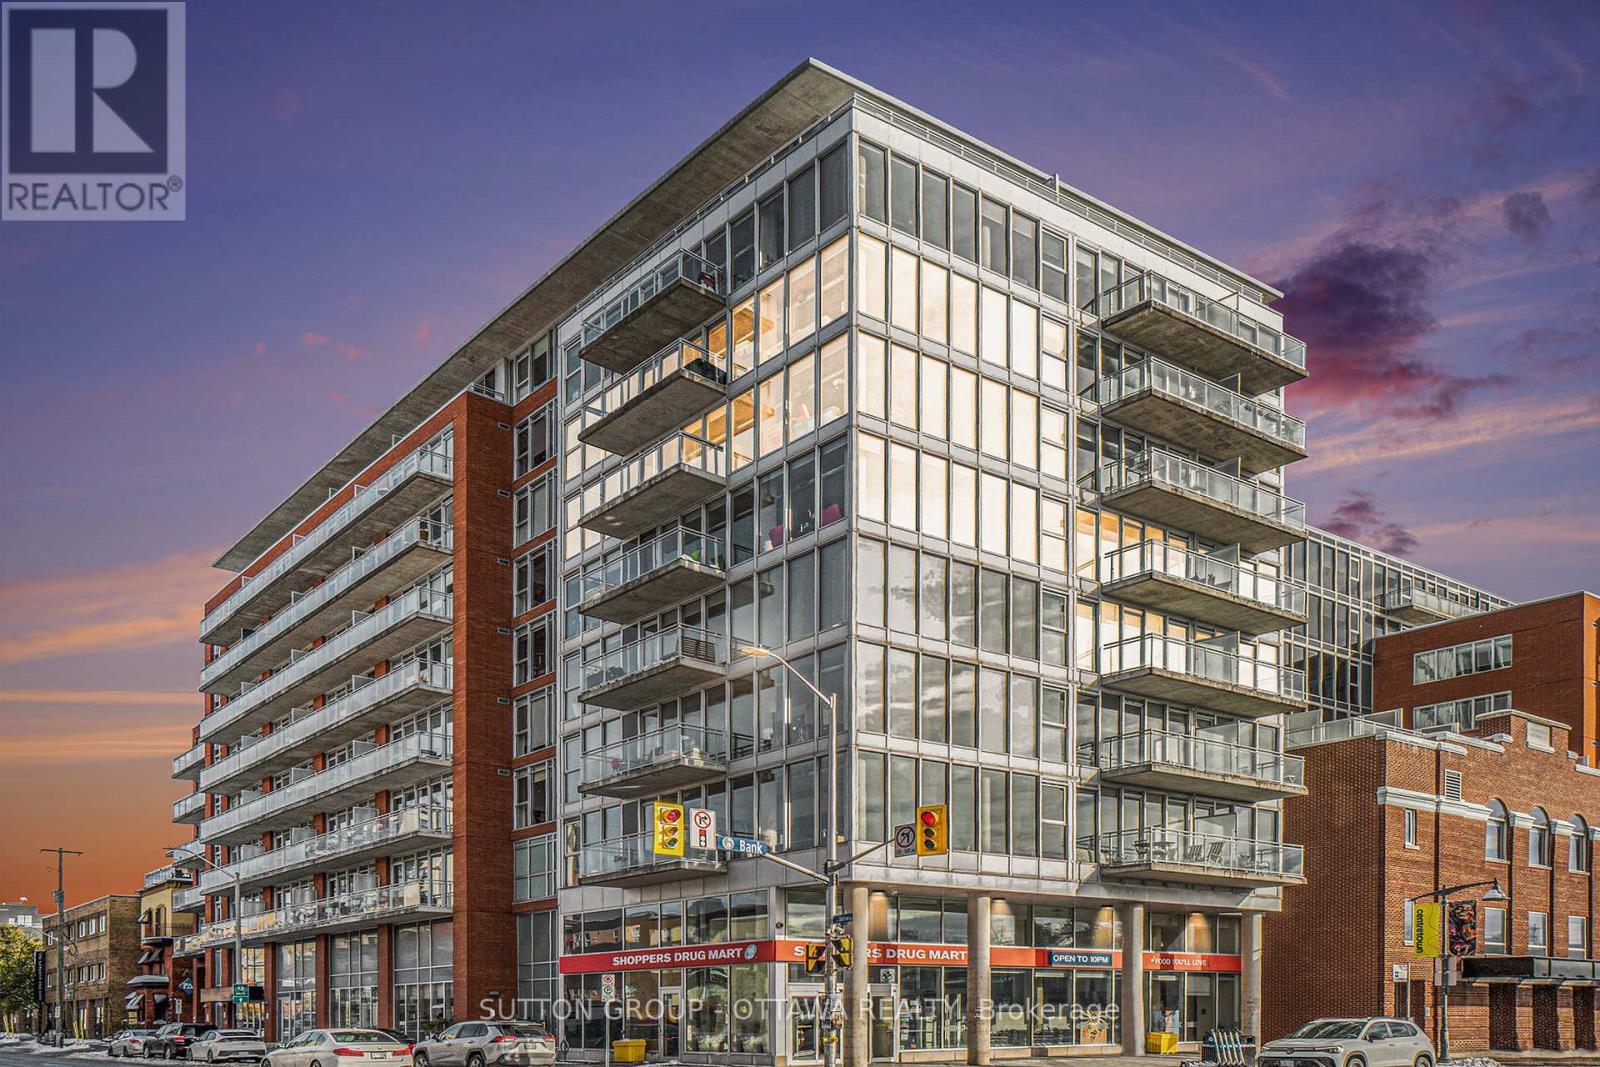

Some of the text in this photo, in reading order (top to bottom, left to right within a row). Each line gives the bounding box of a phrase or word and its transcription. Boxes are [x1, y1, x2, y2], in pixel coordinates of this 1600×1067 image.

[739, 840, 763, 854] Bank
[1416, 909, 1424, 953] centretown
[612, 948, 743, 966] SHOPPERS DRUG MART
[886, 949, 926, 960] DRUG
[929, 950, 968, 961] MART
[1053, 954, 1109, 964] OPEN TO 10PM
